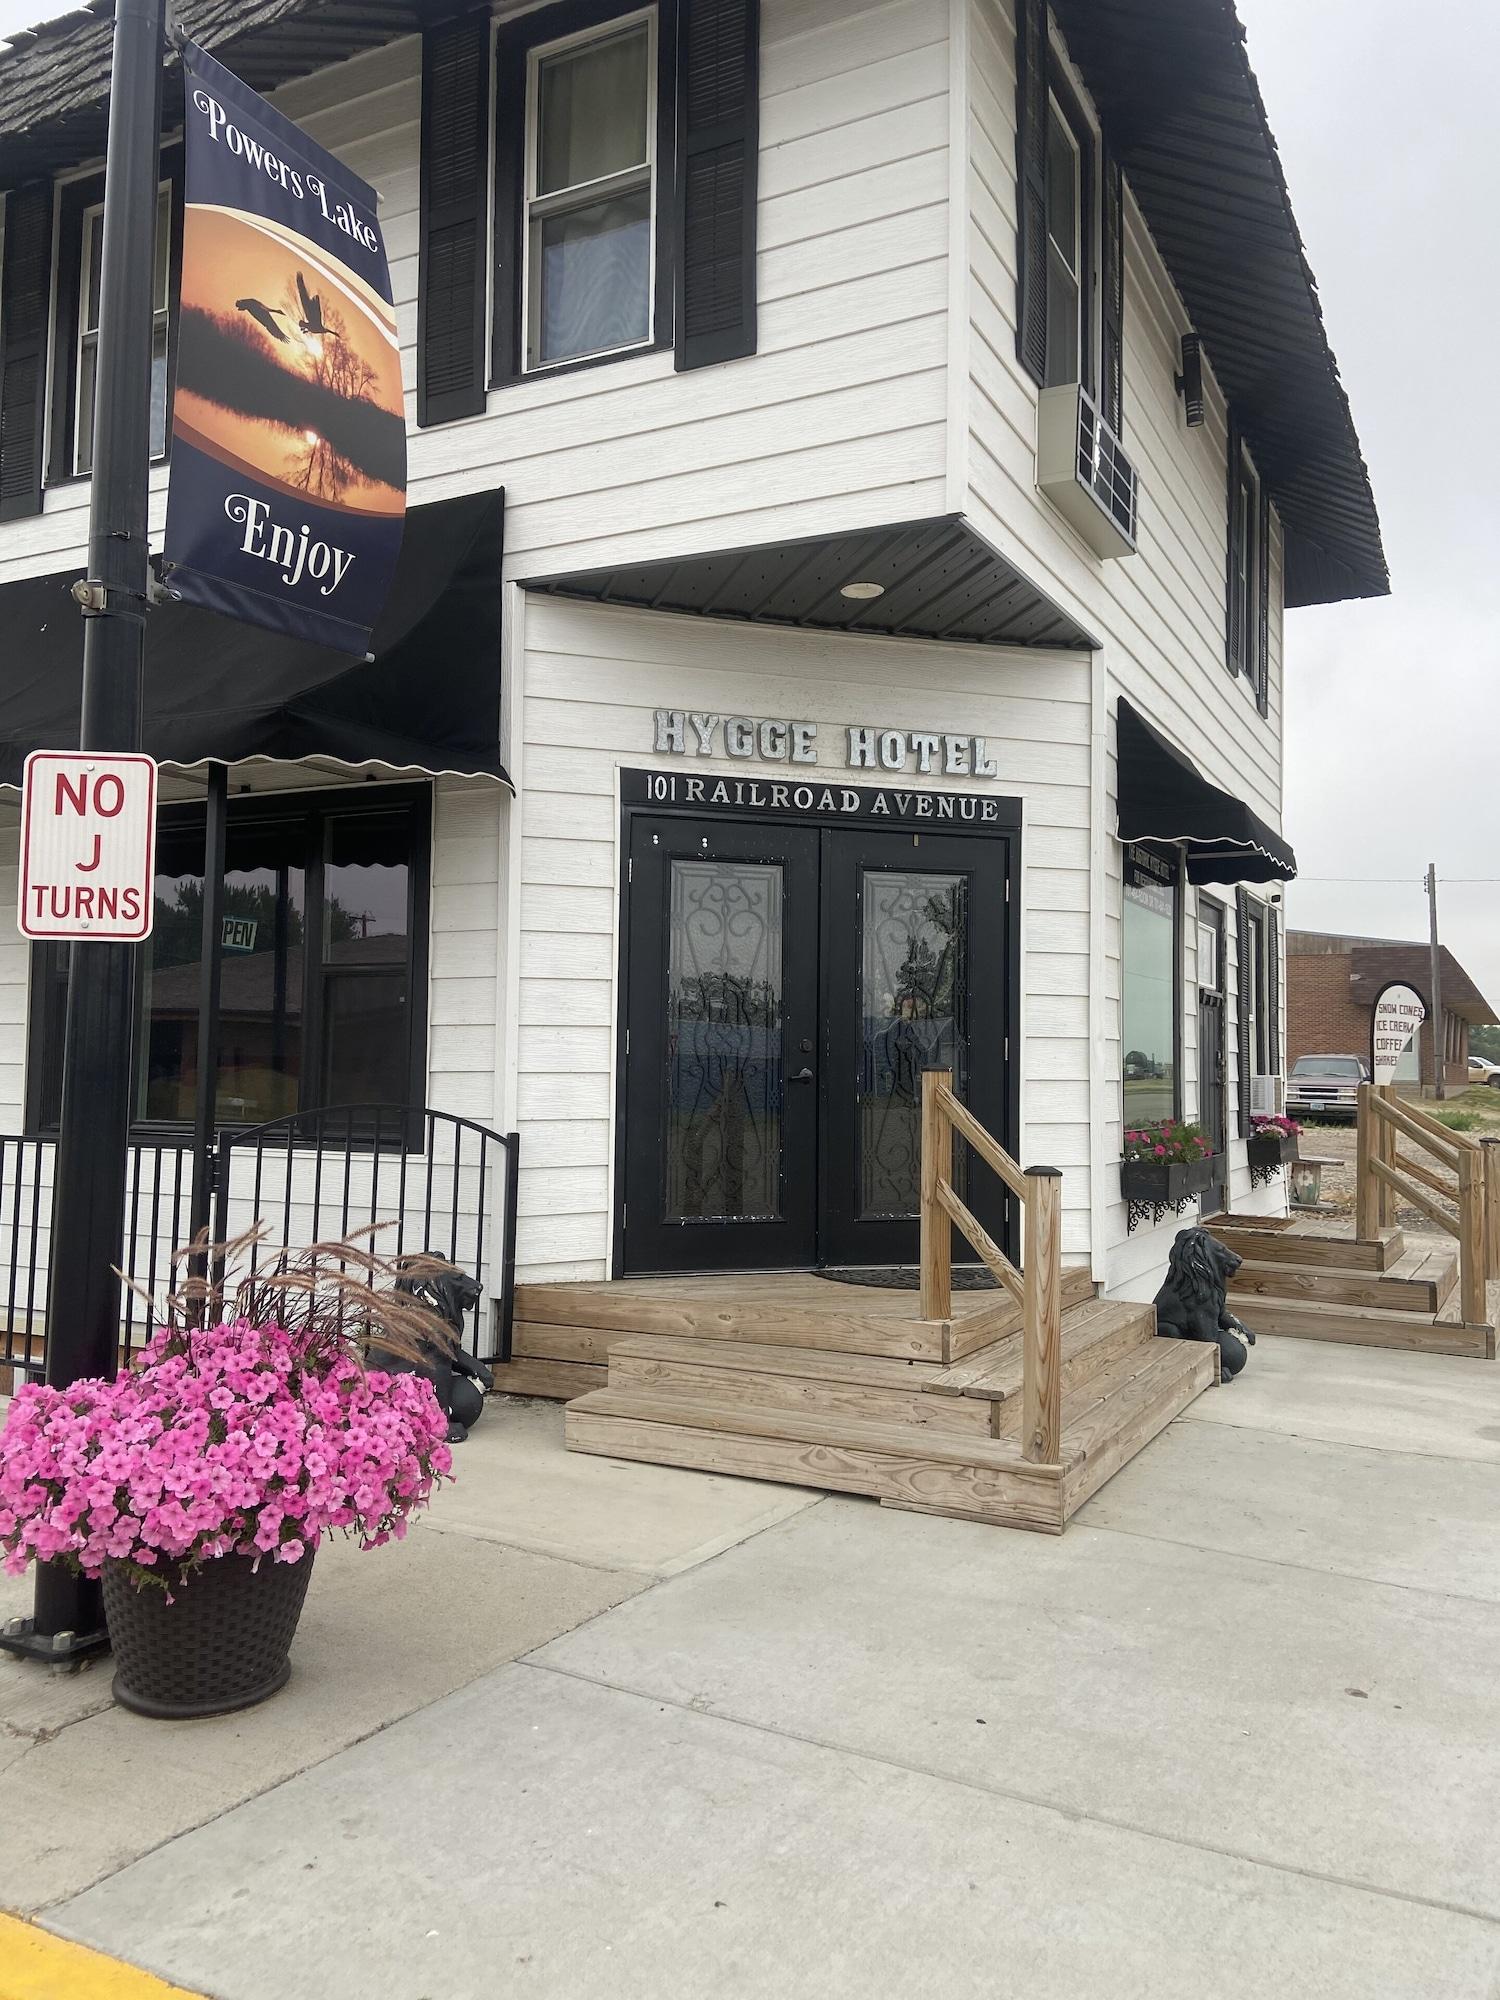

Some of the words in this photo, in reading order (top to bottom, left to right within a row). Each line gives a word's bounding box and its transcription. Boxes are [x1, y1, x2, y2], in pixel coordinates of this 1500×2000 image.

[193, 90, 304, 199] Powers
[306, 174, 378, 253] Lake
[224, 493, 356, 596] Enjoy
[653, 710, 818, 765] HYGGE
[846, 727, 998, 779] HOTEL
[55, 773, 125, 818] NO
[647, 775, 677, 801] 101
[685, 778, 860, 813] RAILROAD
[871, 792, 1000, 822] AVENUE
[75, 834, 101, 872] J
[32, 885, 140, 921] TURNS
[223, 919, 254, 947] PEN
[1376, 1020, 1388, 1031] ICE
[1390, 1020, 1415, 1034] CREAM
[1378, 1003, 1397, 1014] SNOW
[1399, 1004, 1423, 1017] CONES
